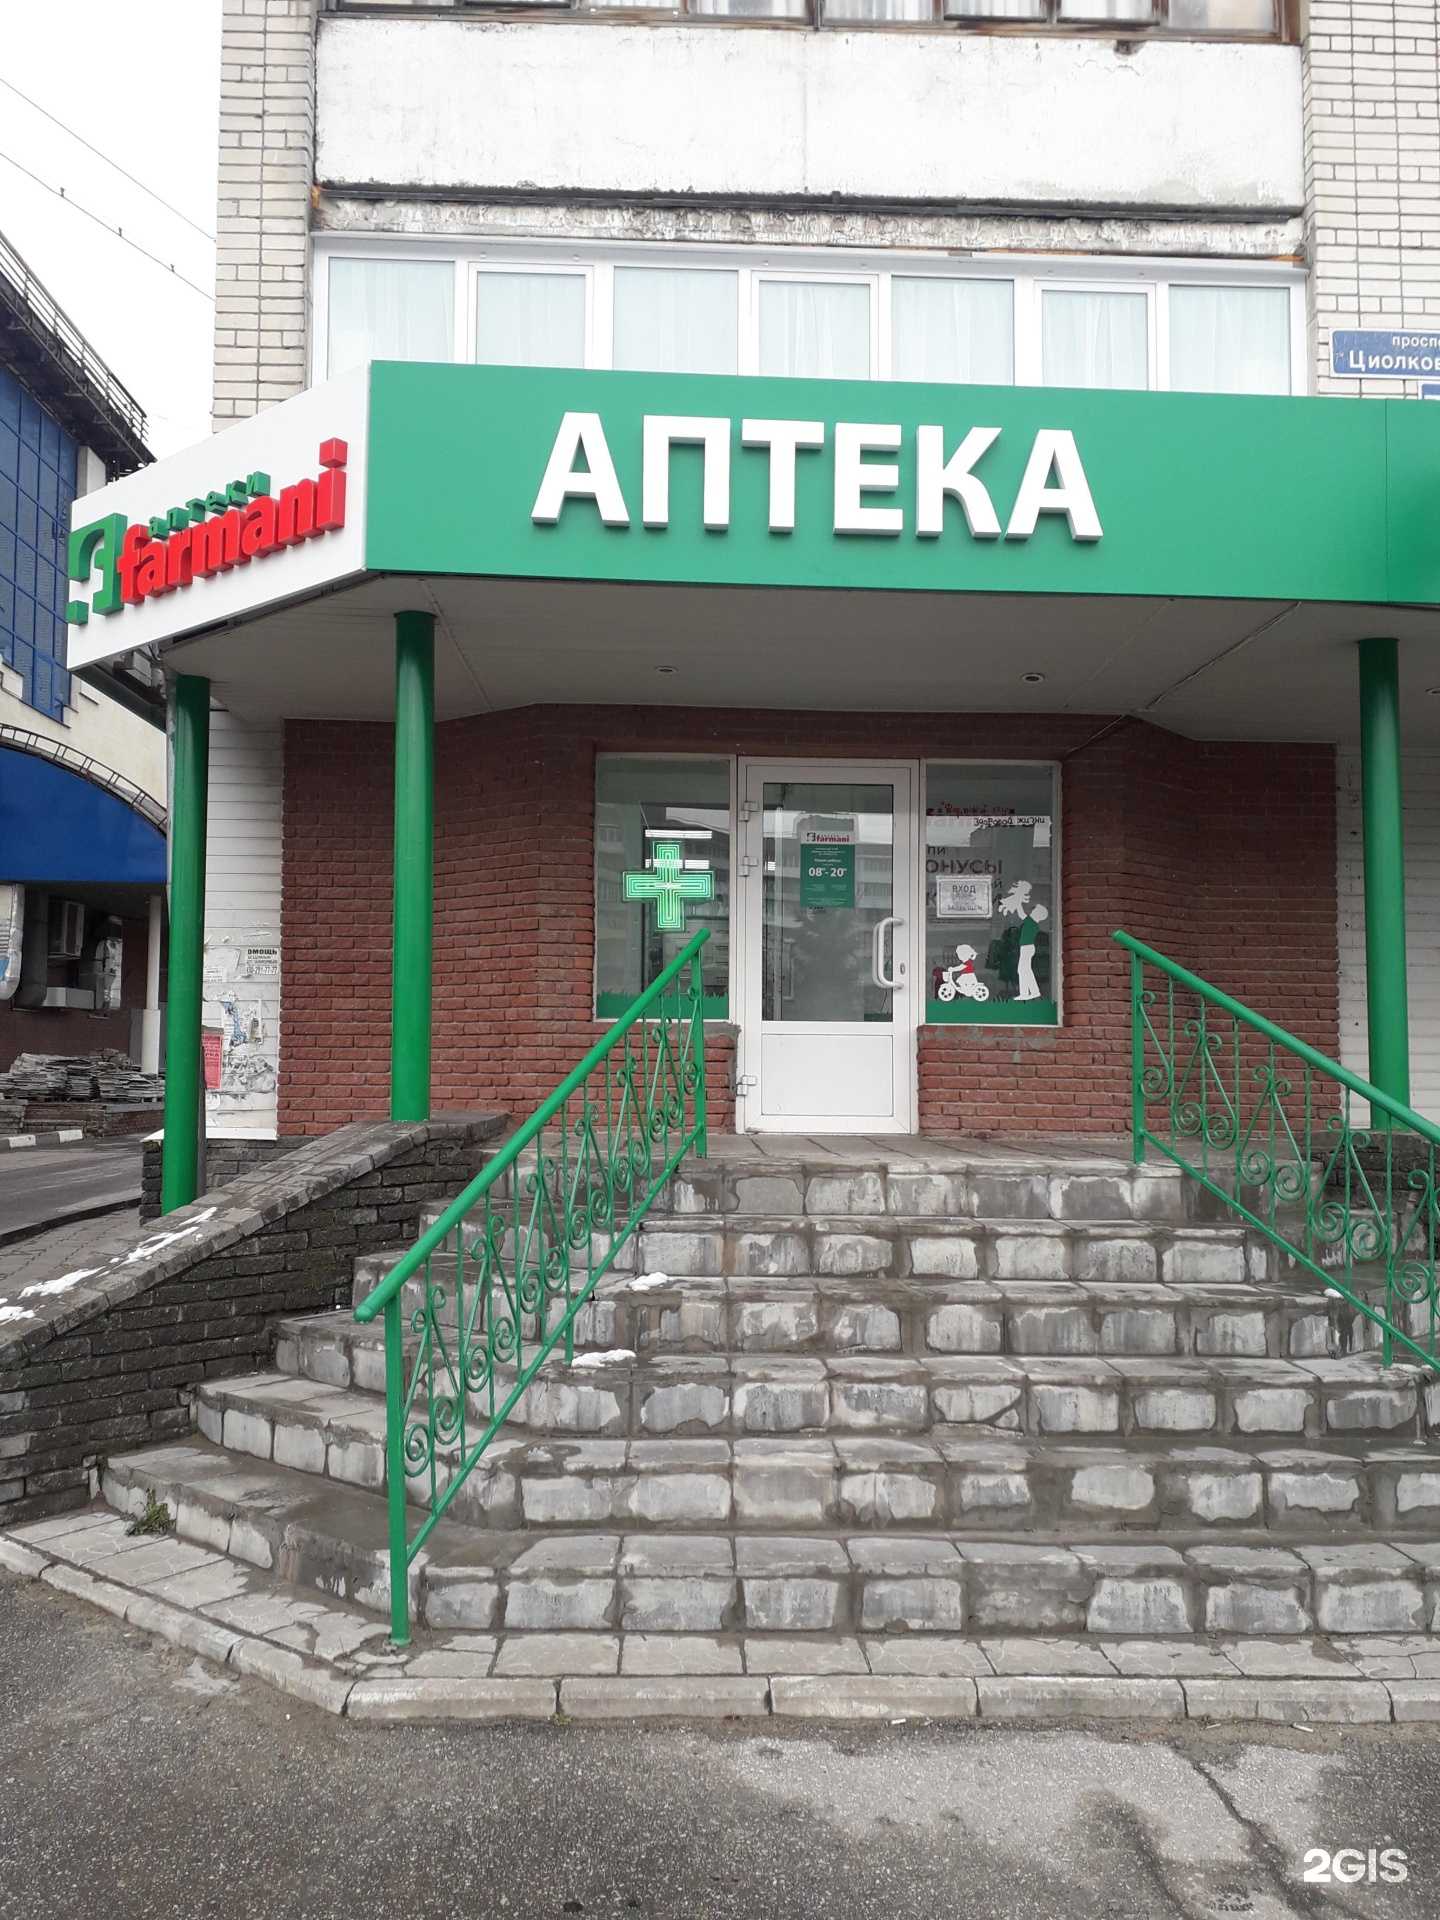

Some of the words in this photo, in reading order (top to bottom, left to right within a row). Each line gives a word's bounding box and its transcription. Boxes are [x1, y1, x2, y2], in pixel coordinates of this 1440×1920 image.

[1392, 336, 1440, 350] просп
[148, 471, 271, 540] аптеки
[530, 411, 1103, 541] АПТЕКА
[117, 437, 348, 605] farmani
[952, 884, 976, 895] ВХОД
